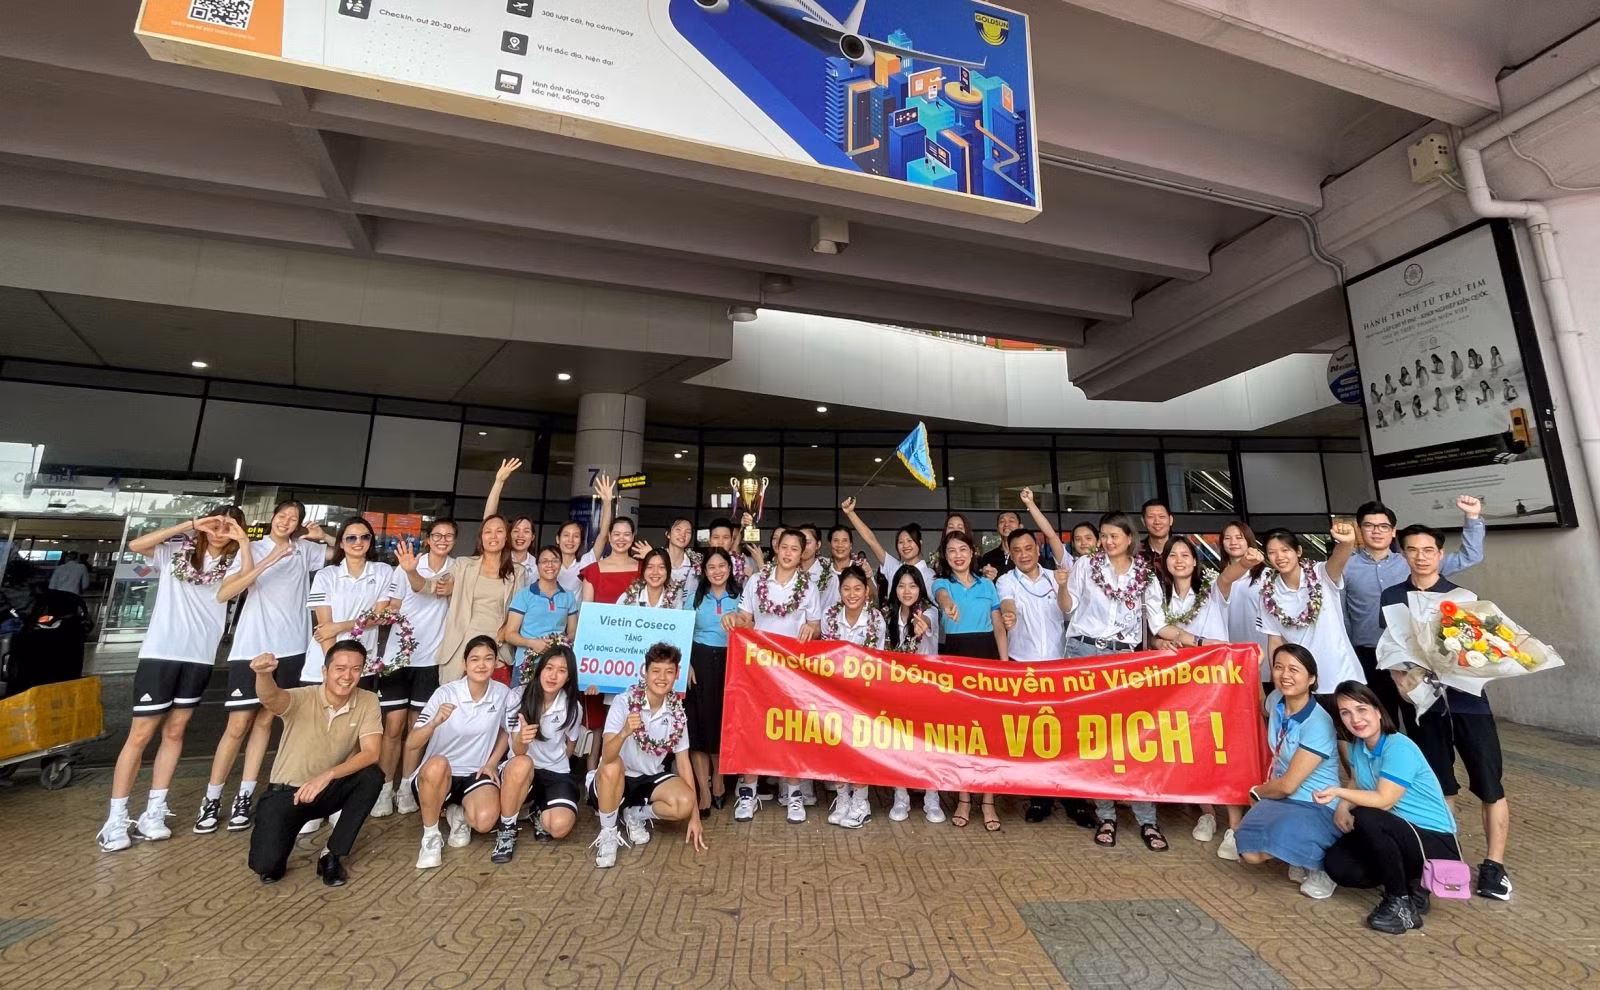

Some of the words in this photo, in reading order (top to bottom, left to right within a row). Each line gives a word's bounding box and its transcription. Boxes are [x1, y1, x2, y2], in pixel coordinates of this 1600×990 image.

[430, 19, 452, 29] 20-30
[453, 24, 471, 33] phút
[541, 10, 554, 18] 300
[585, 20, 595, 28] hạ
[975, 15, 1009, 29] GOLDSUN
[532, 80, 548, 89] Hình
[549, 83, 564, 92] ảnh
[565, 87, 589, 98] quảng
[562, 94, 580, 103] sống
[581, 98, 600, 108] động
[1464, 279, 1488, 292] TIM
[588, 468, 600, 487] 7
[600, 615, 632, 628] Vietin
[635, 618, 677, 631] Coseco
[583, 644, 595, 653] ĐỘI
[596, 644, 614, 653] BÓNG
[745, 642, 836, 678] Fanclub
[843, 654, 883, 687] Đội
[890, 660, 954, 693] bóng
[962, 666, 1056, 697] chuyền
[1062, 670, 1096, 693] nữ
[1100, 659, 1245, 689] VietinBank
[765, 703, 843, 746] CHÀO
[851, 710, 915, 752] ĐÓN
[923, 720, 989, 756] NHÀ
[1001, 705, 1062, 759] VÔ
[1077, 710, 1195, 774] ĐỊCH
[1209, 711, 1228, 765] !
